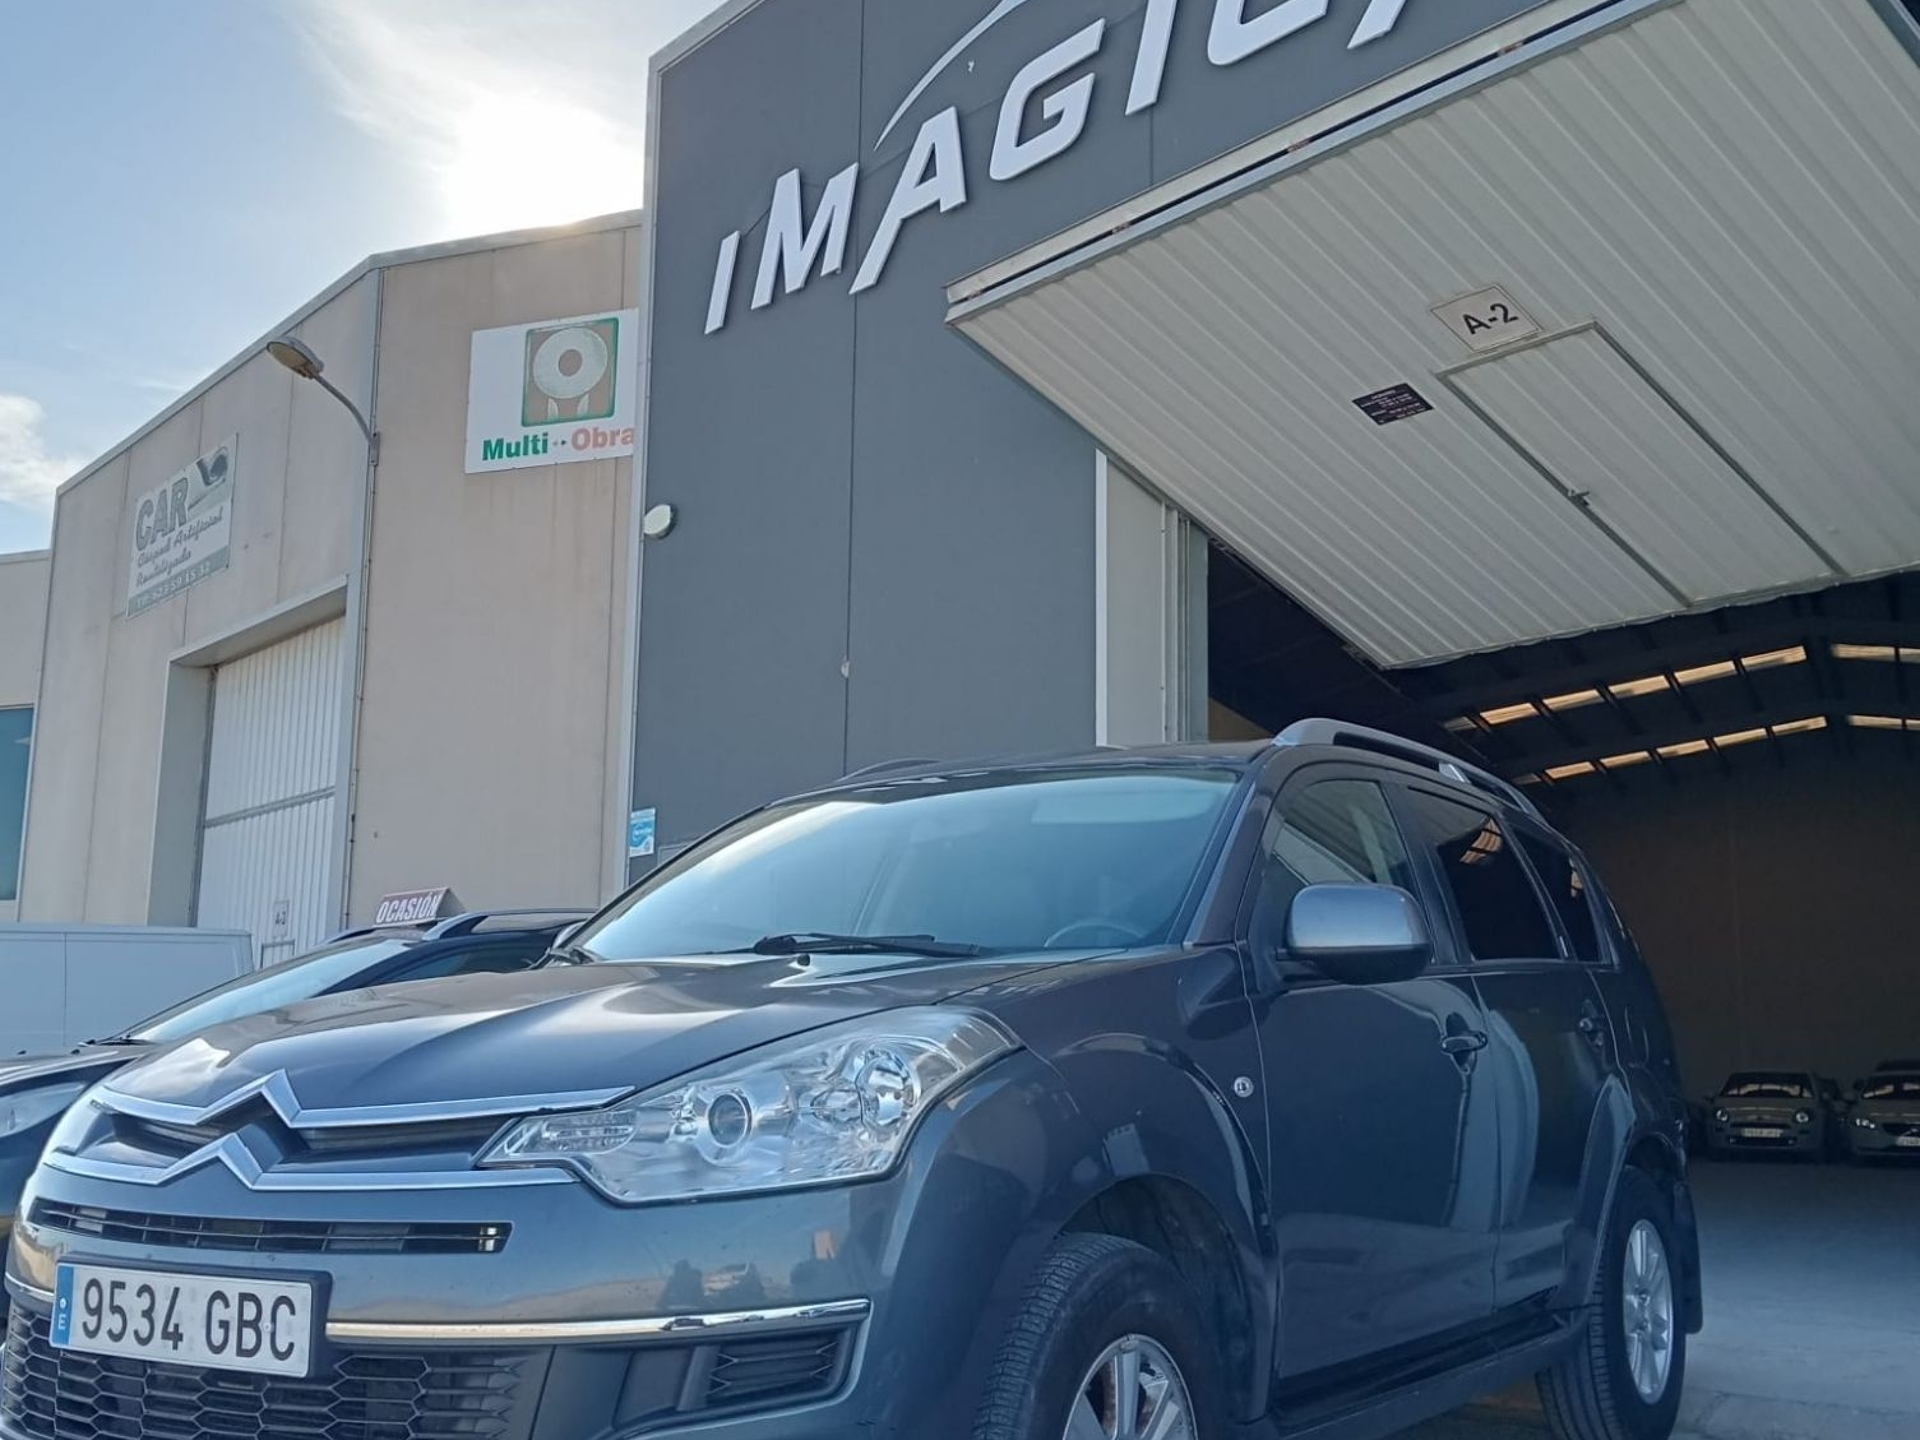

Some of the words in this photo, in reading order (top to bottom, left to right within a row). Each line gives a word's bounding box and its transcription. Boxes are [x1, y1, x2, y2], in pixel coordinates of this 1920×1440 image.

[1462, 303, 1519, 334] A-2
[482, 433, 548, 460] Multi
[571, 427, 634, 451] Obra
[136, 477, 189, 551] CAR
[376, 892, 443, 924] OCASIÓN
[82, 1278, 184, 1351] 9534
[205, 1290, 296, 1361] GBC
